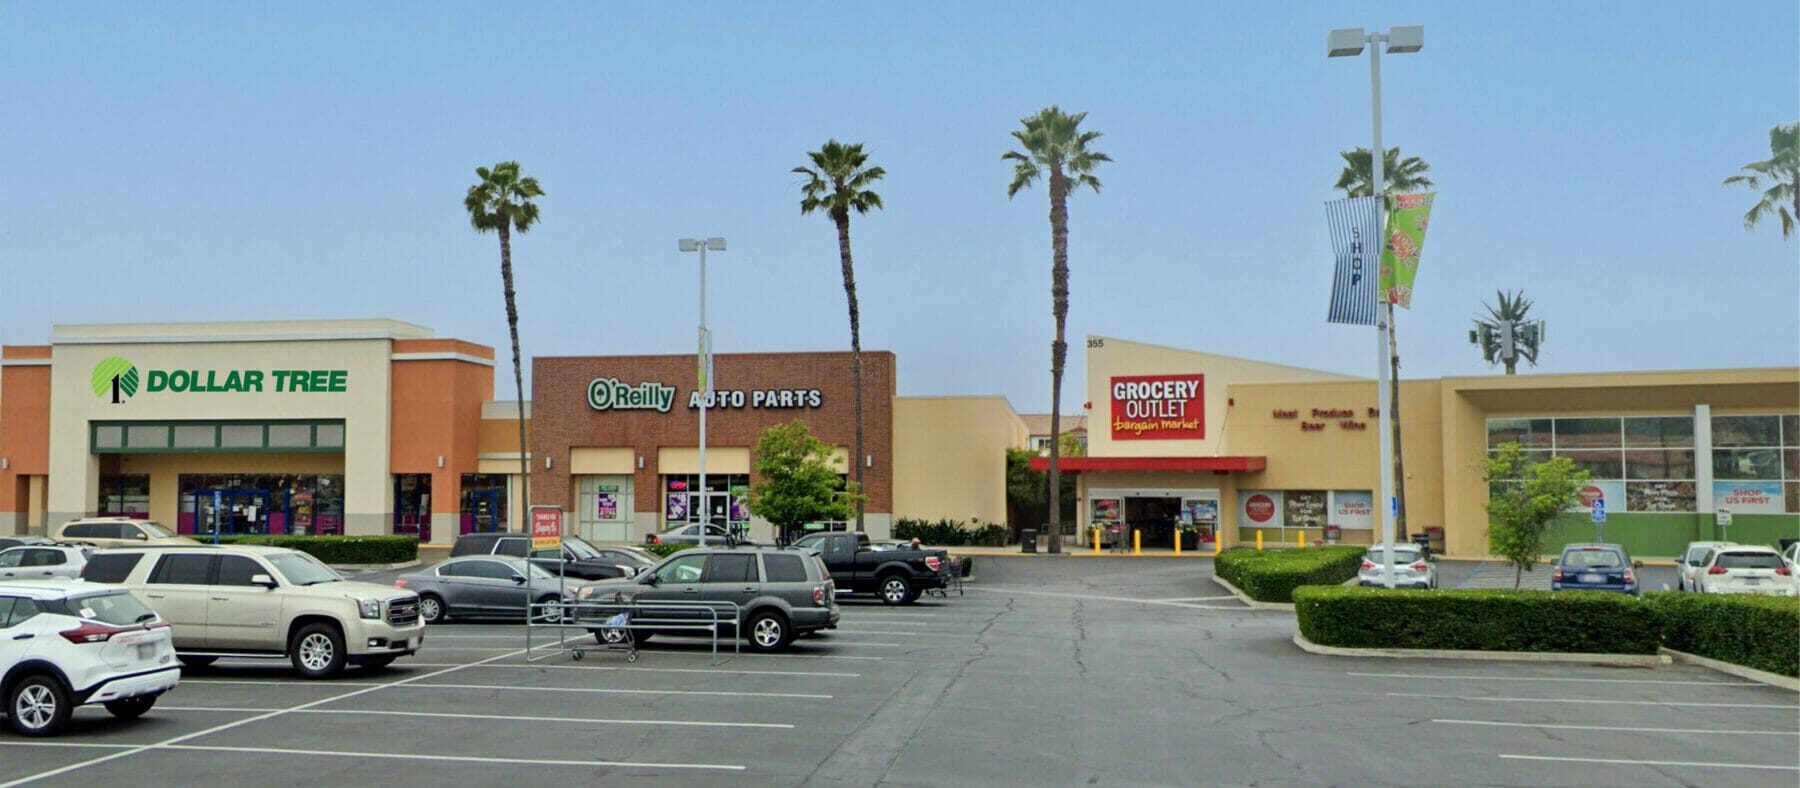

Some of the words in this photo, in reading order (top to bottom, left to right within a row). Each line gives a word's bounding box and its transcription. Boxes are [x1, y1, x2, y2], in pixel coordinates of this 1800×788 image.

[1352, 227, 1362, 286] SHOP
[1087, 339, 1104, 348] 355
[147, 370, 264, 393] DOLLAR
[272, 370, 348, 393] TREE
[1113, 380, 1199, 400] GROCERY
[588, 378, 675, 411] O'Reilly
[689, 390, 745, 408] AUTO
[752, 389, 822, 408] PARTS
[1126, 399, 1187, 418] OUTLET
[1113, 415, 1158, 435] bargain
[1161, 418, 1199, 430] market
[1725, 497, 1739, 505] US
[1741, 497, 1770, 505] FIRST
[1733, 489, 1762, 497] SHOP
[1350, 508, 1372, 516] FIRST
